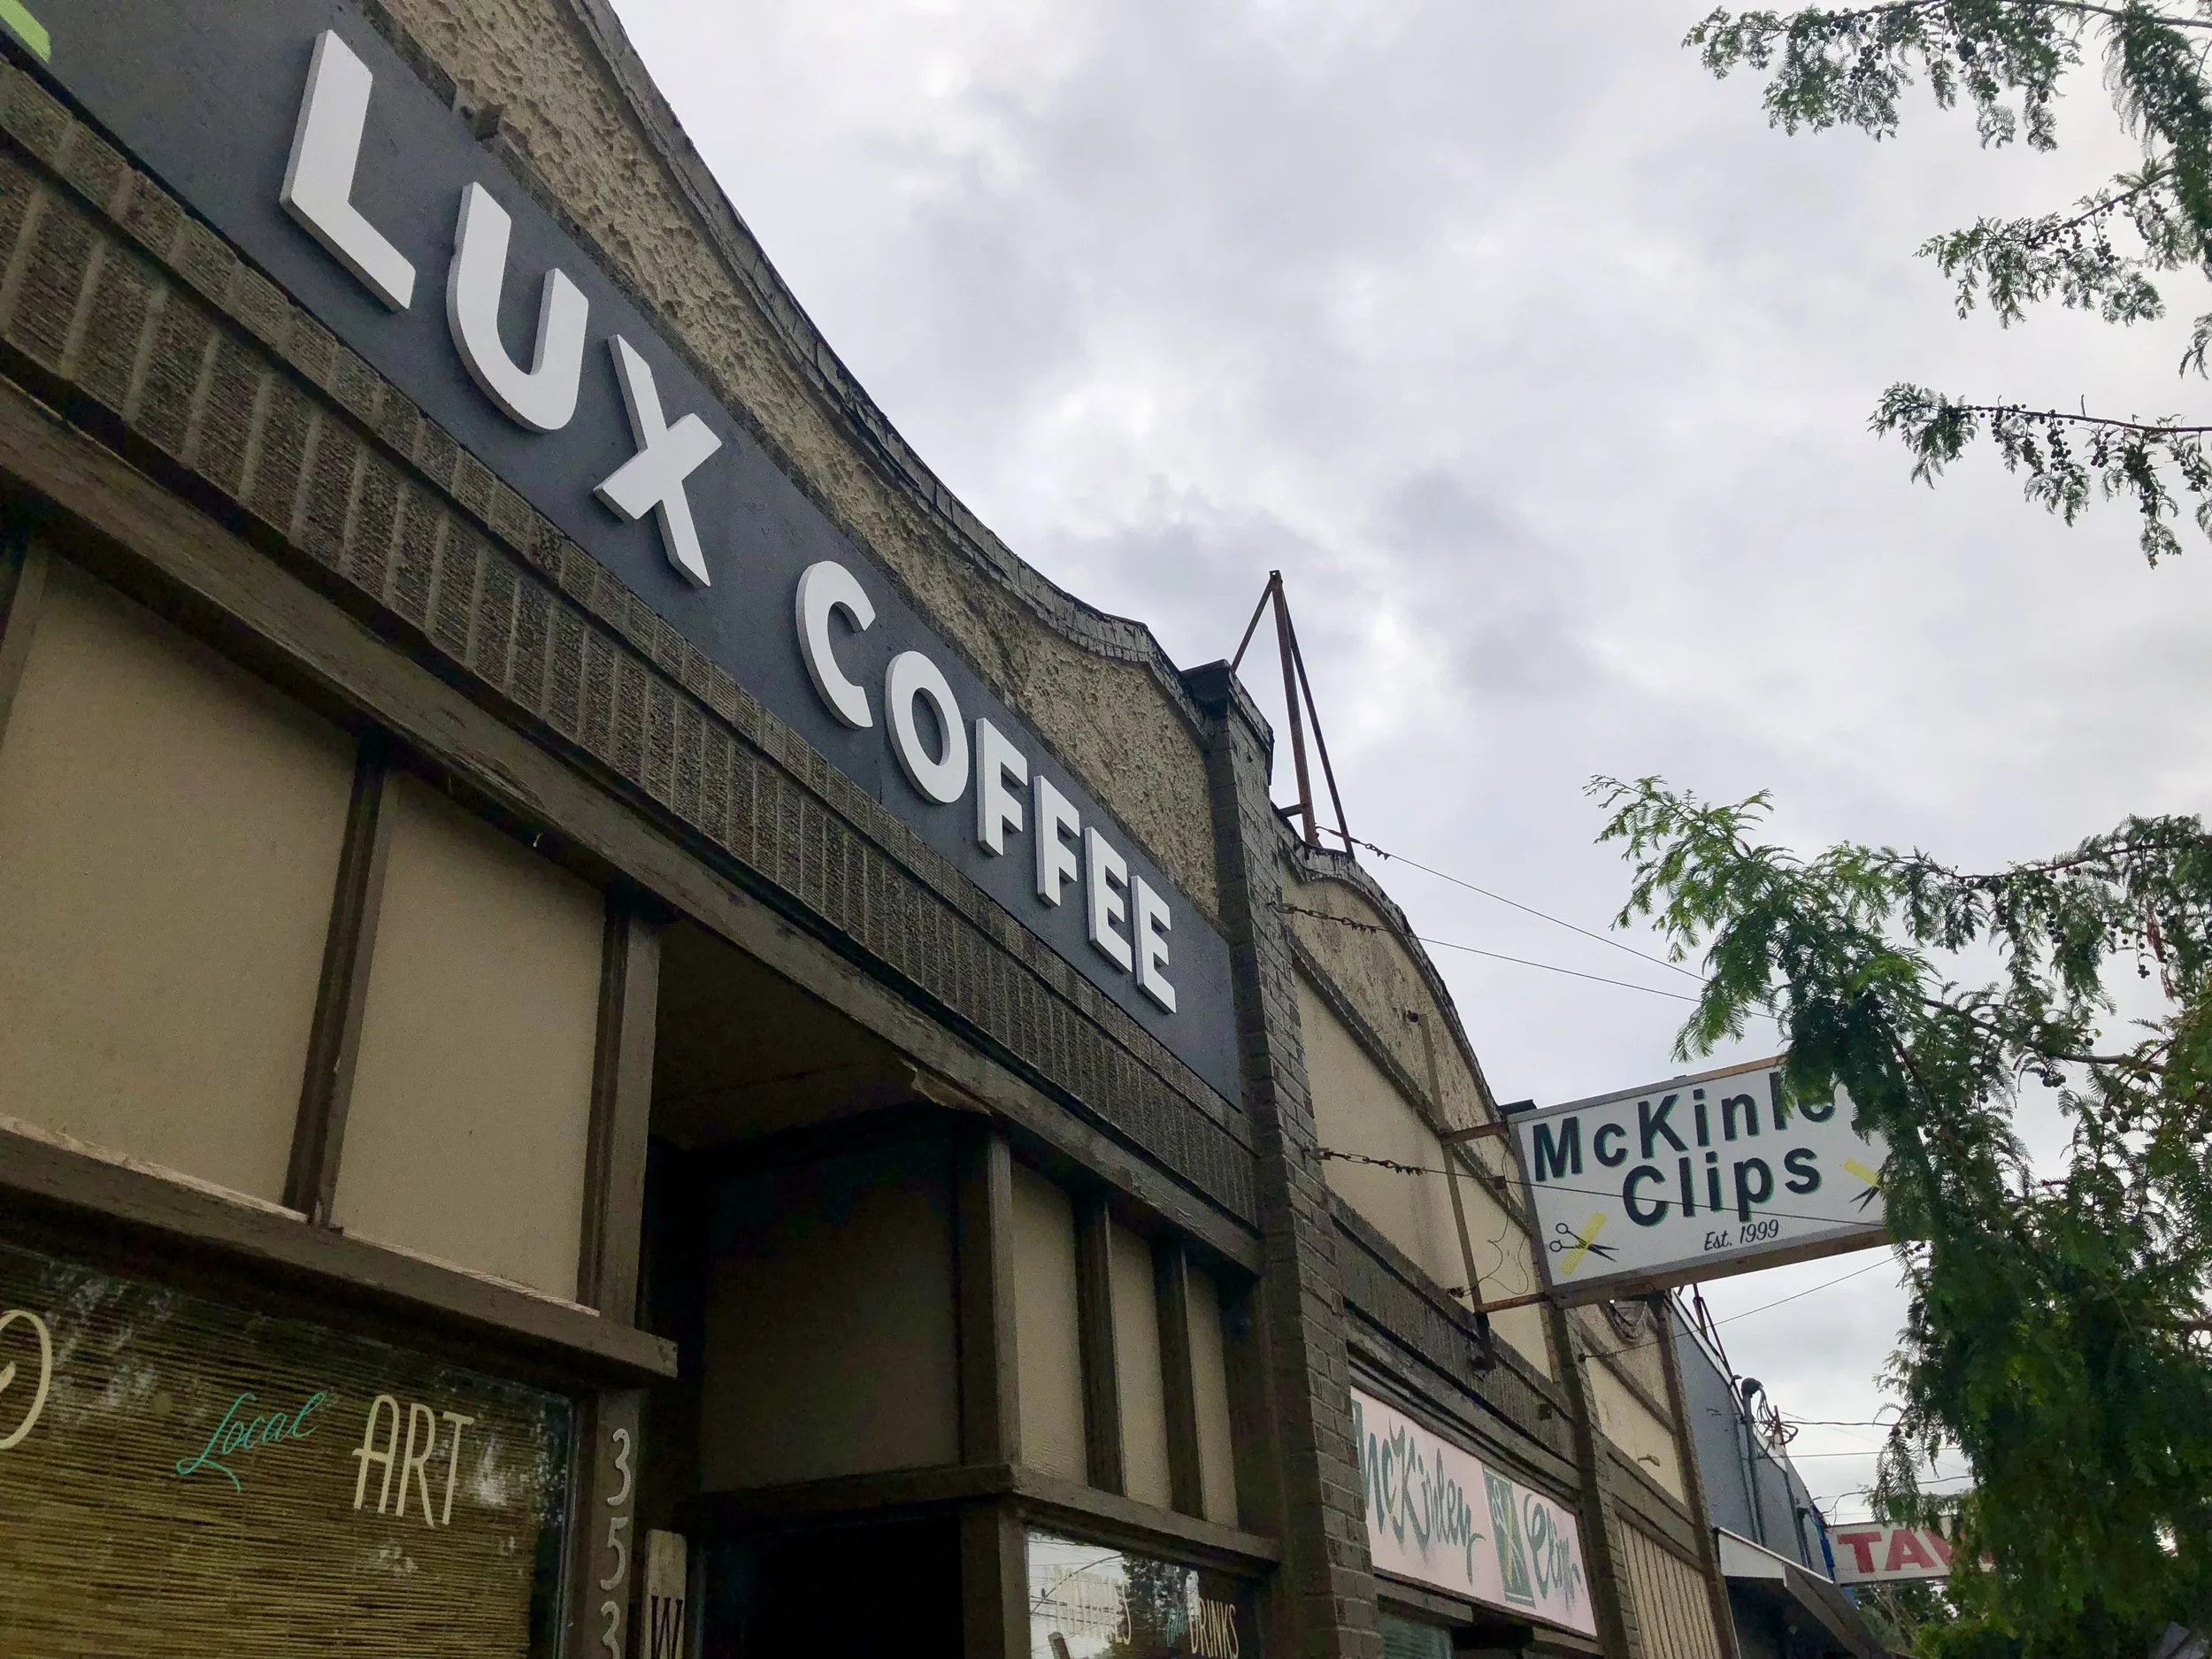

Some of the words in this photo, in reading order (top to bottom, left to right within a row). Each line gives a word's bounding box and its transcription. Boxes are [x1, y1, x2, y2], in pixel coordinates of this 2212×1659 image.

[280, 29, 722, 588] LUX
[796, 561, 1177, 1013] COFFEE
[1532, 1071, 1835, 1182] McKinl
[1623, 1148, 1823, 1226] Clips
[1704, 1230, 1732, 1252] Est.
[1739, 1219, 1779, 1245] 1999
[177, 1392, 327, 1493] Local
[352, 1394, 475, 1529] ART
